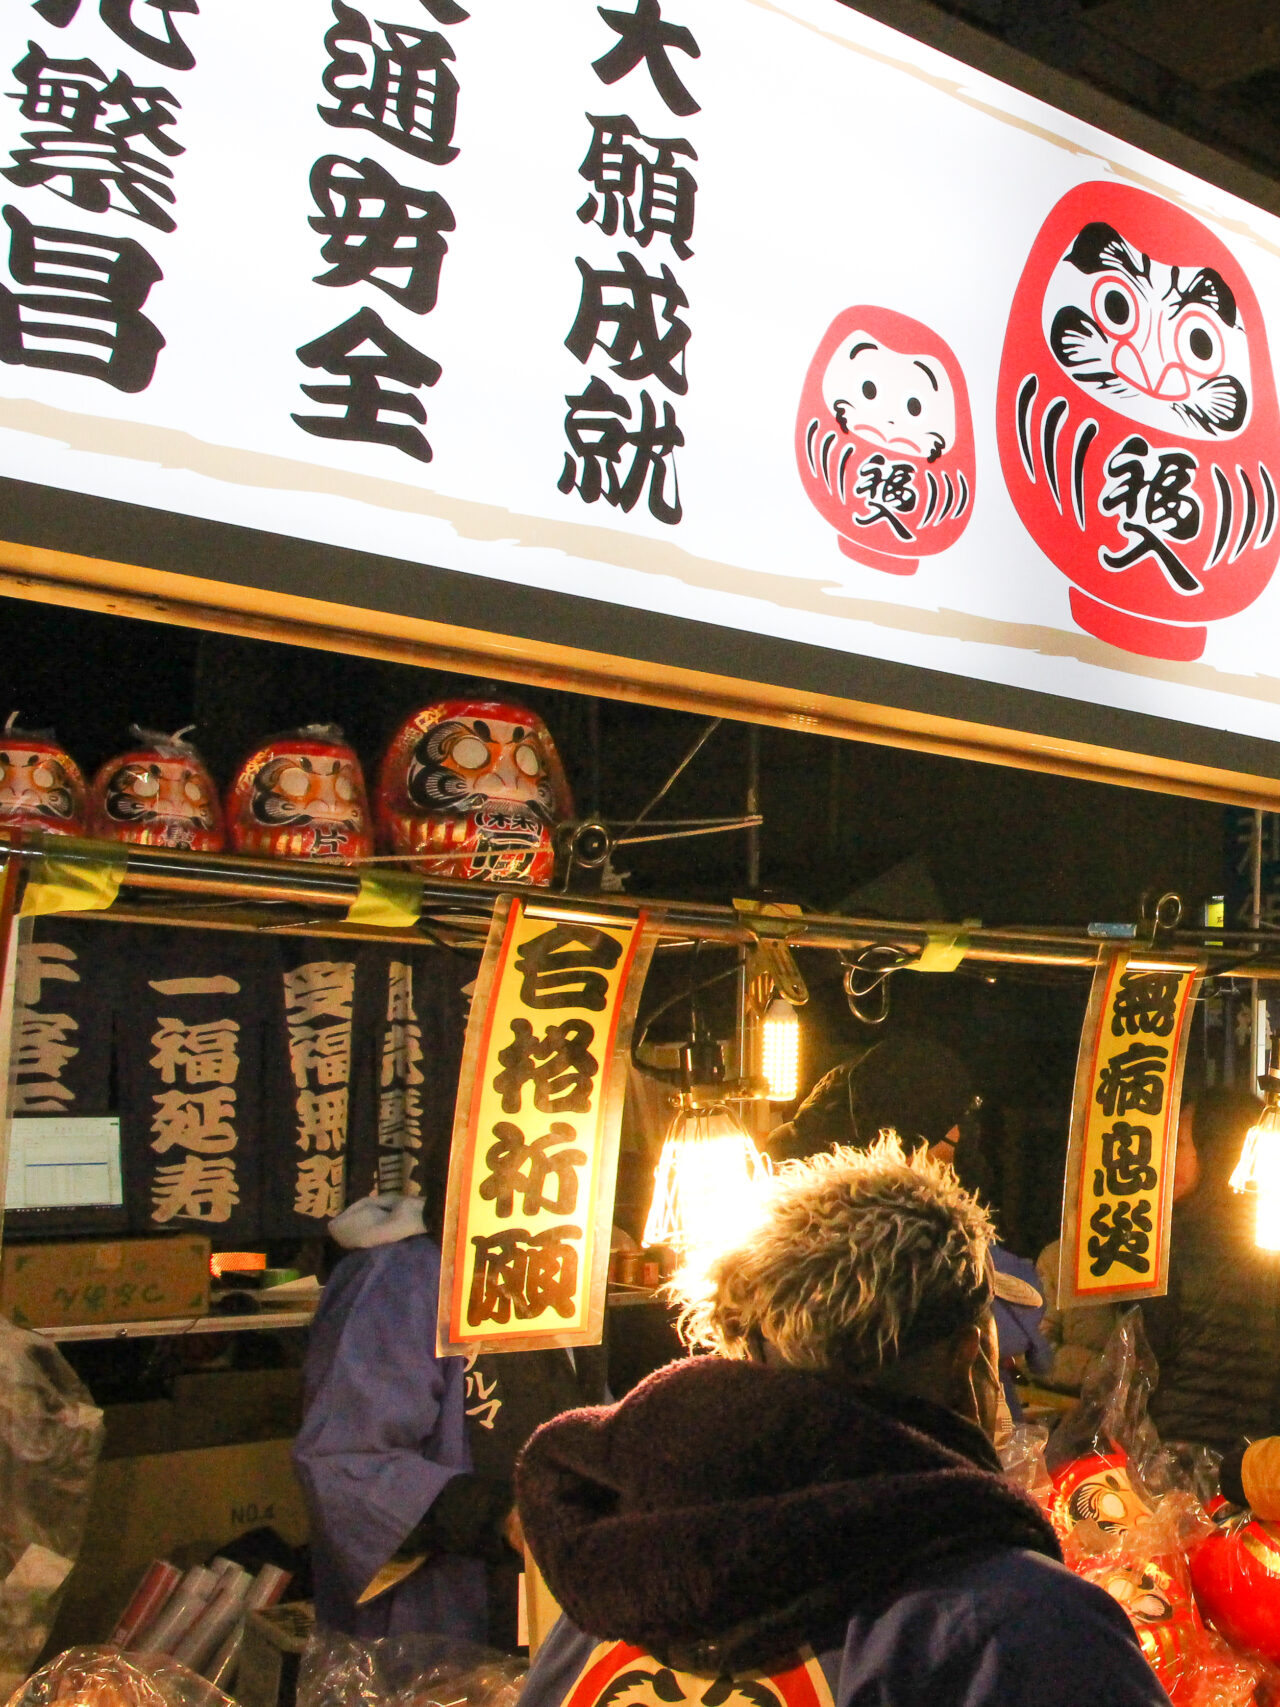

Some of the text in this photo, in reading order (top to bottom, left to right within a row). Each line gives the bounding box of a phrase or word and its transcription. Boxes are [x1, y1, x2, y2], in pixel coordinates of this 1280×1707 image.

[290, 0, 473, 464] 通安全
[556, 0, 702, 525] 大願成就
[148, 974, 241, 1223] 一福延寿
[467, 924, 625, 1328] 合格祈願
[1087, 971, 1184, 1278] 無病息災
